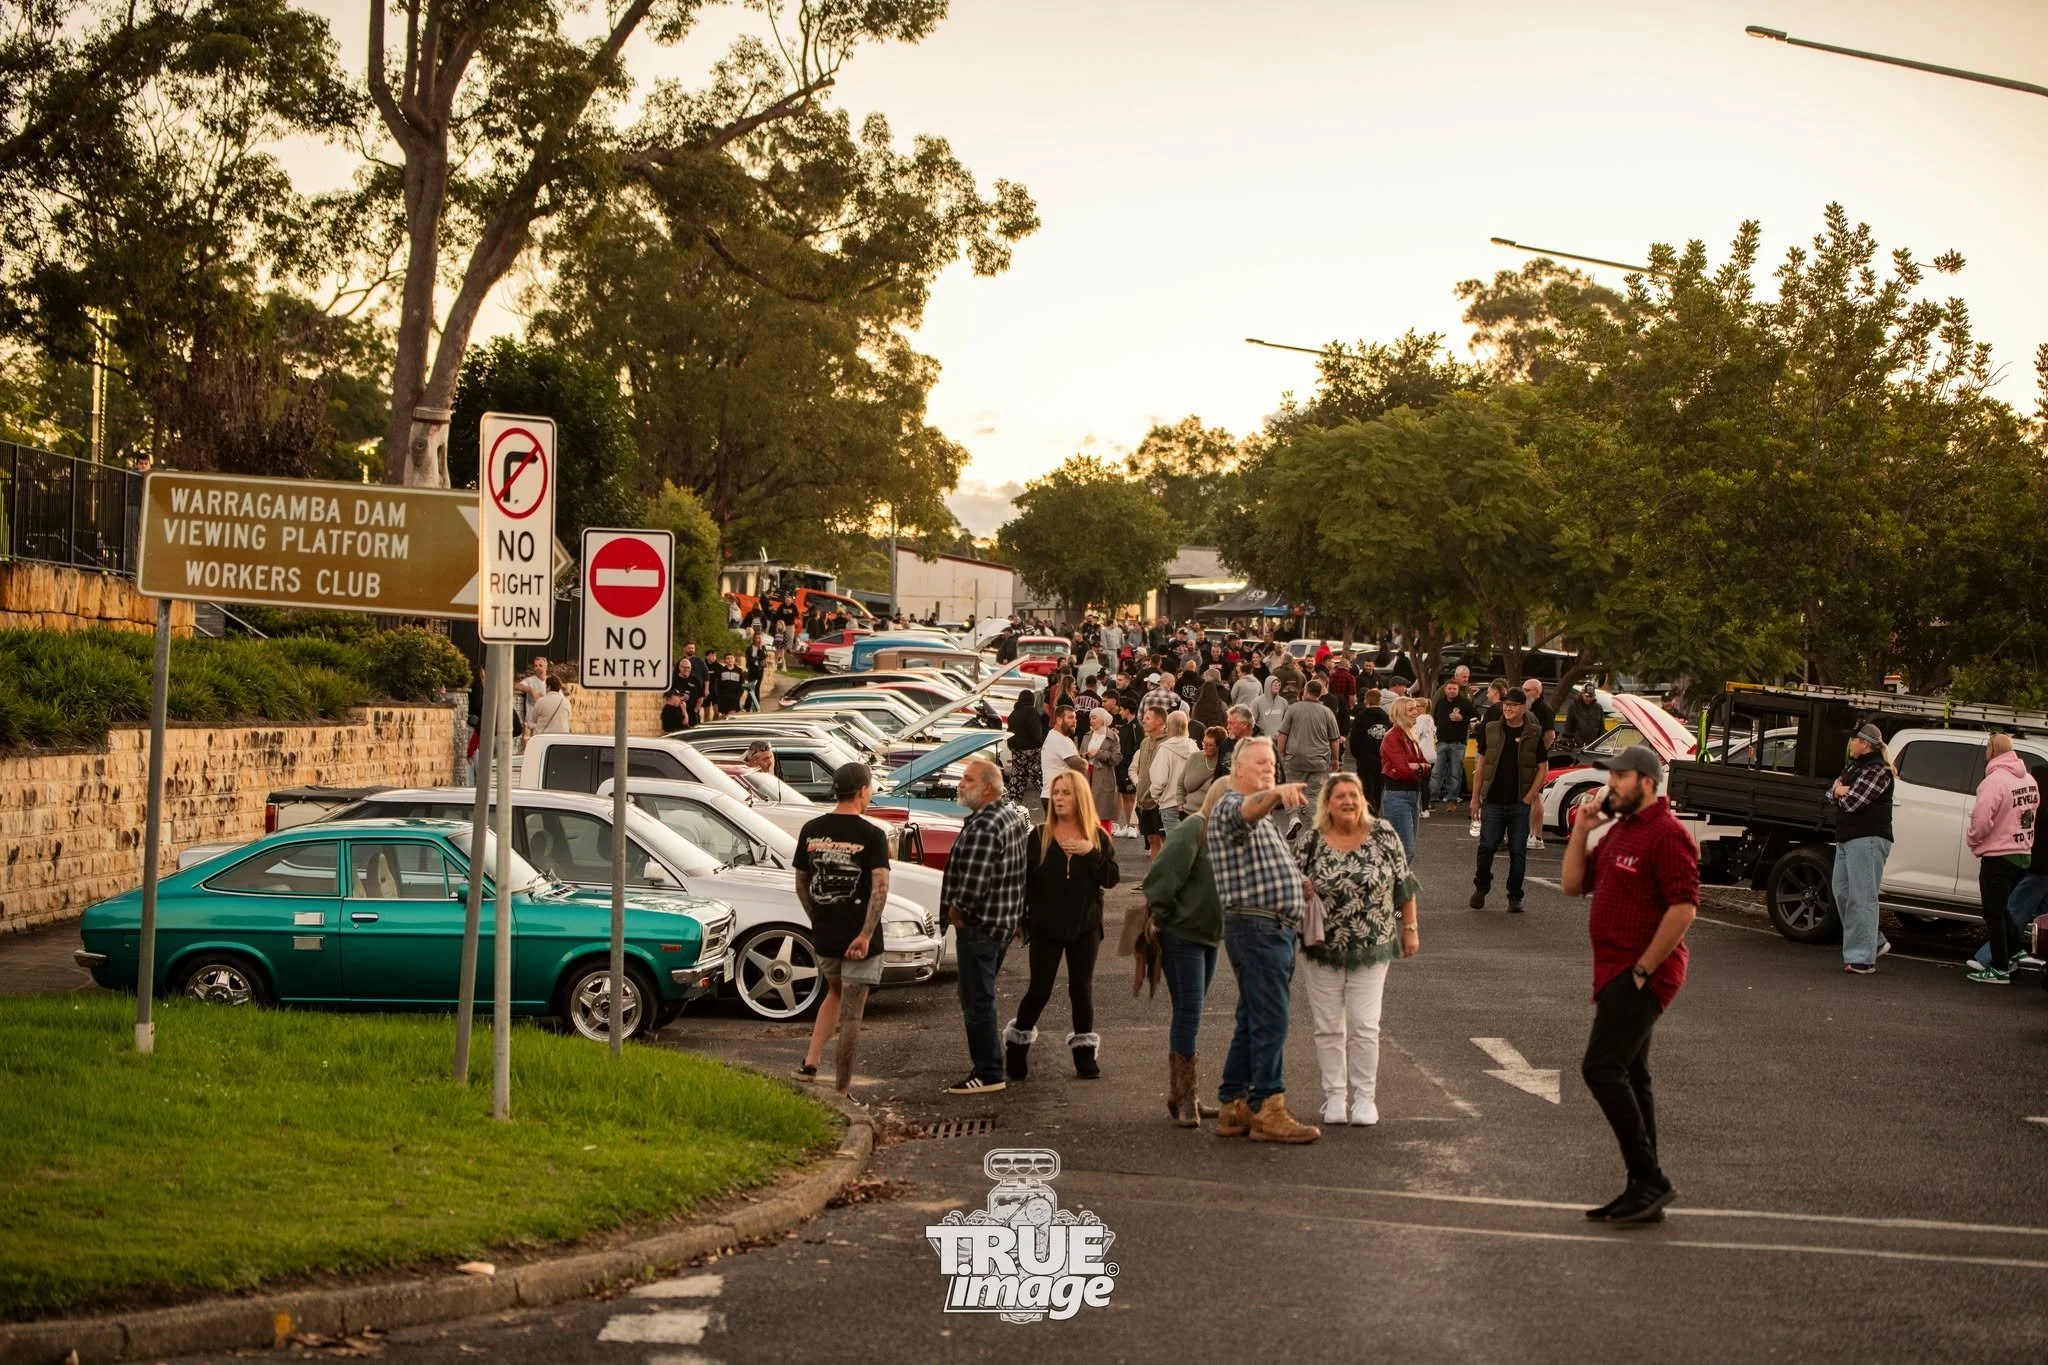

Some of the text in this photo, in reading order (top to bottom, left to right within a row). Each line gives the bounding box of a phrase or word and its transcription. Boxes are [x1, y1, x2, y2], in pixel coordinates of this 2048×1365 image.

[171, 487, 406, 528] WARRAGAMBA DAM
[163, 518, 409, 560] VIEWING PLATFORM
[498, 529, 535, 562] NO
[185, 560, 381, 598] WORKERS CLUB
[490, 572, 544, 596] RIGHT
[491, 605, 540, 629] TURN
[606, 626, 646, 650] NO
[589, 658, 661, 678] ENTRY
[2012, 794, 2038, 808] LEVELS
